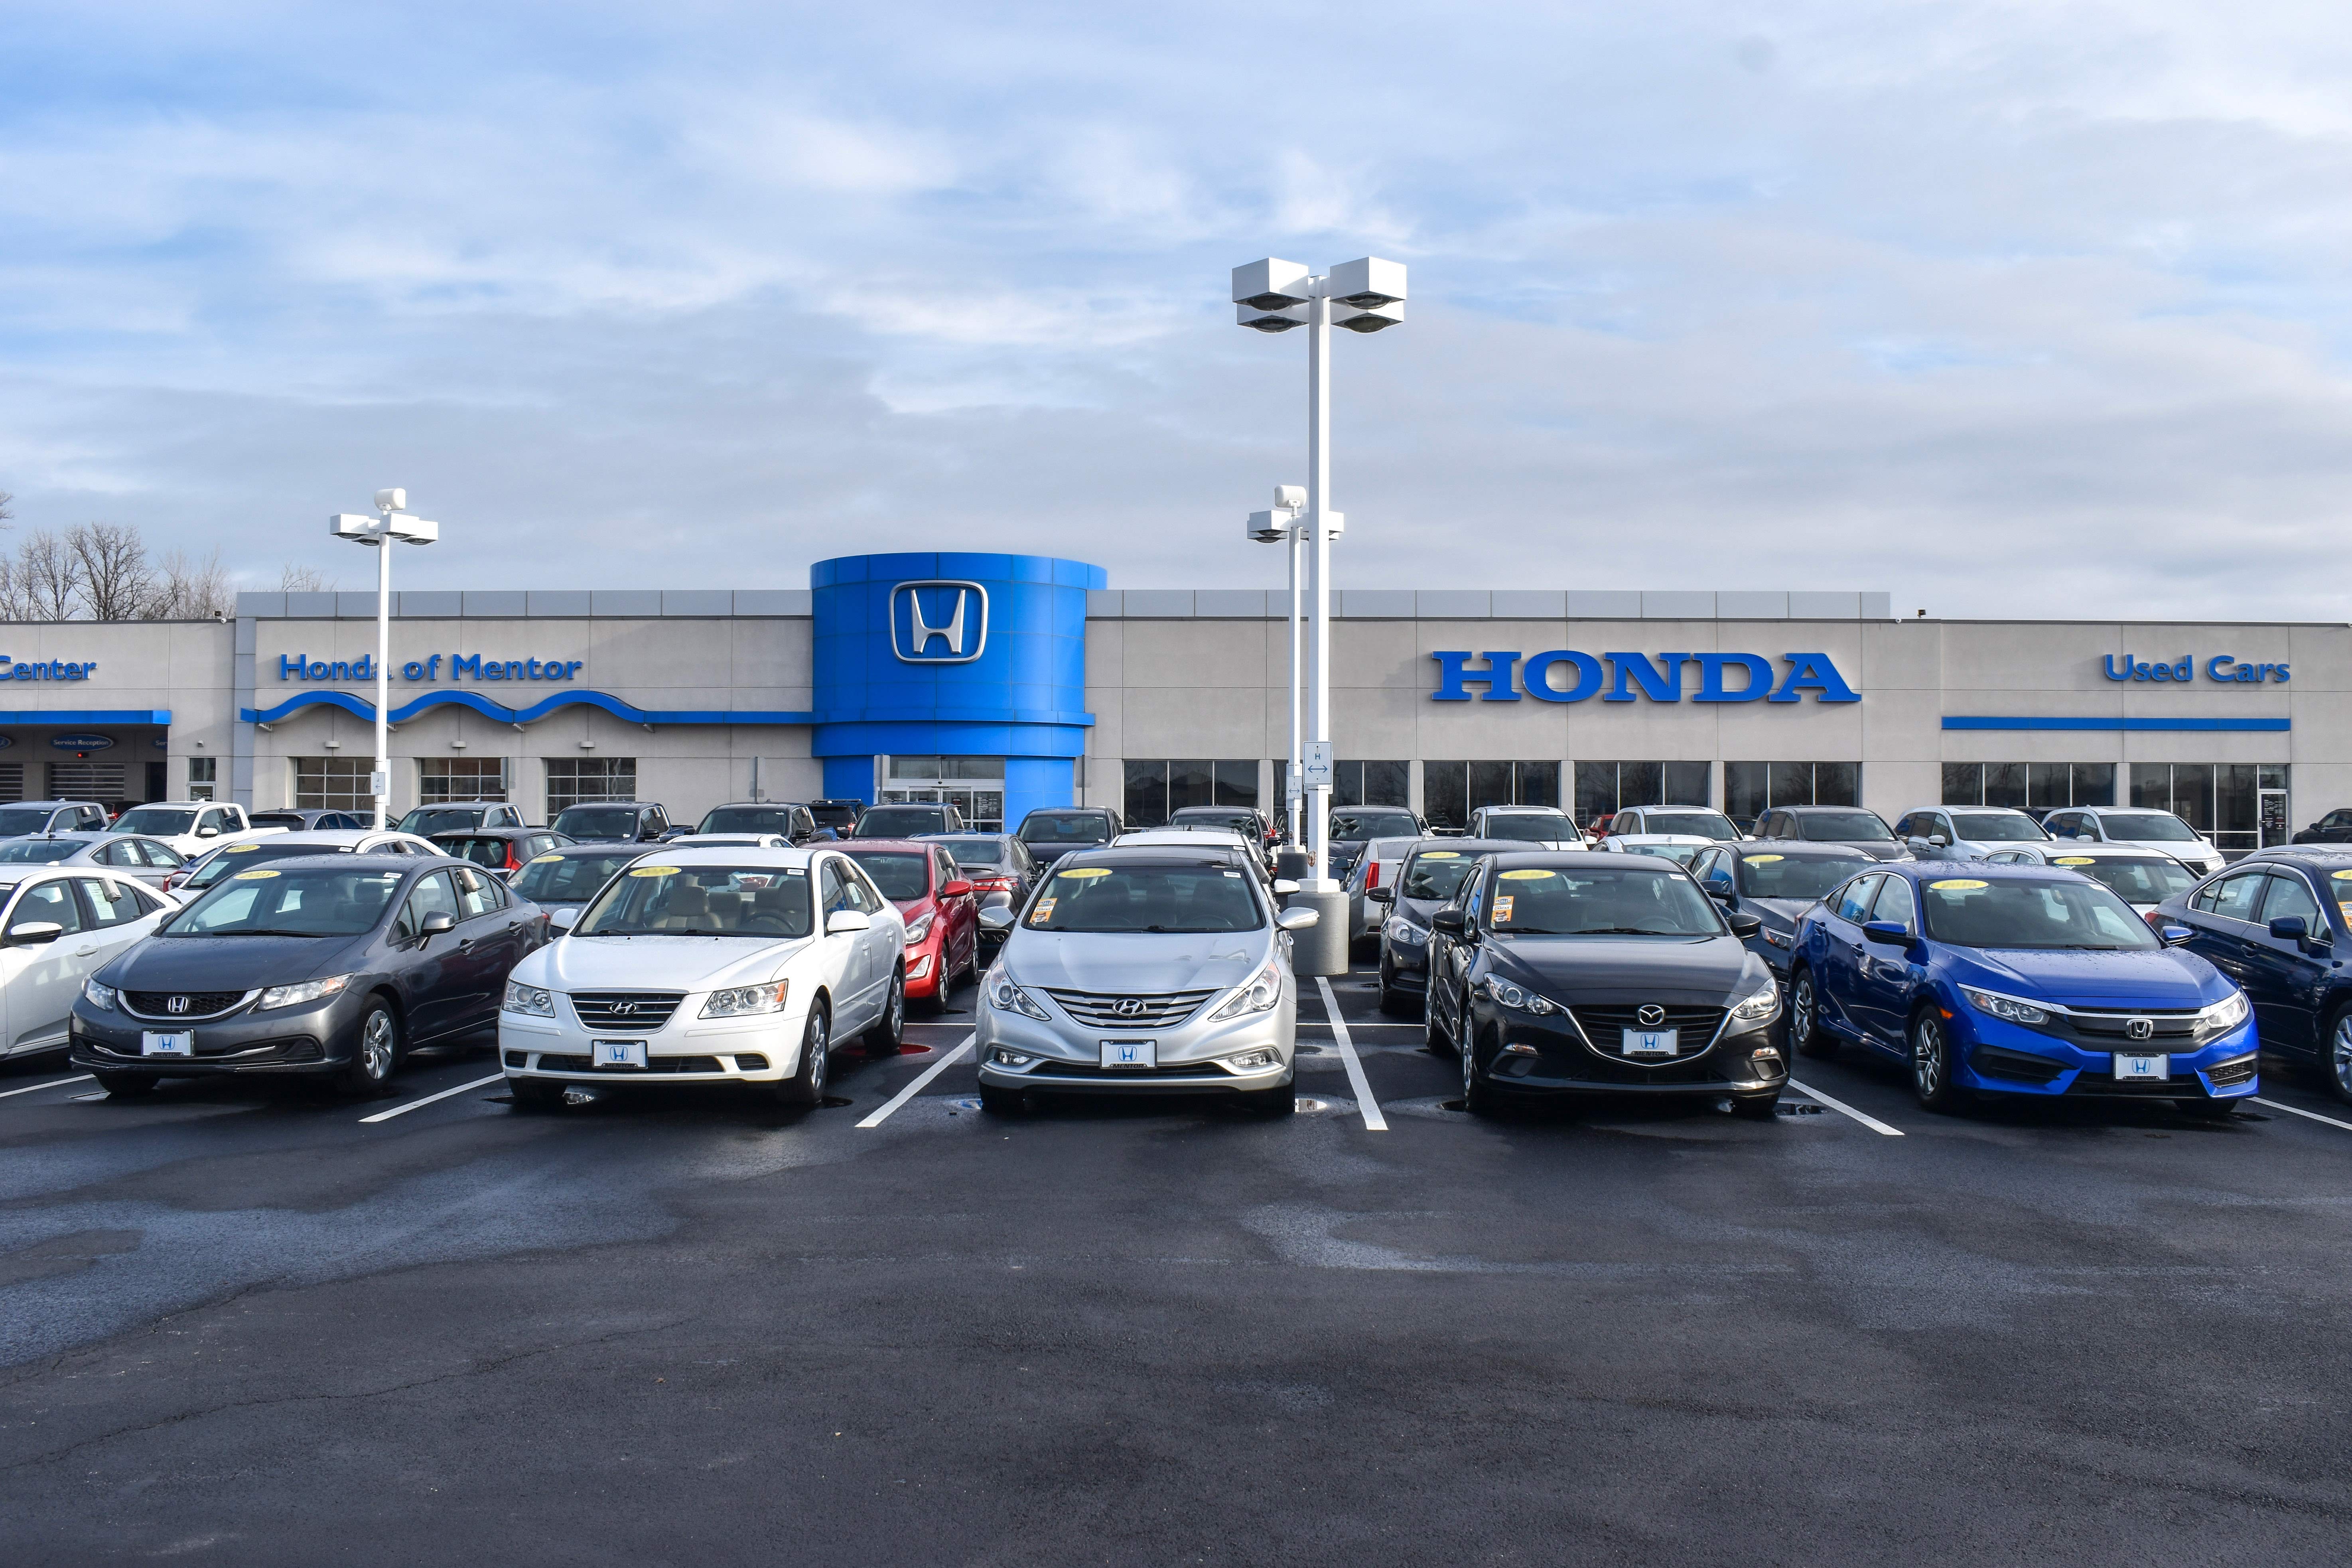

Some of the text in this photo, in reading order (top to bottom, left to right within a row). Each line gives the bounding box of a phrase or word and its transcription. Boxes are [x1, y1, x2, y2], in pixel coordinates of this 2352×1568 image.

[402, 654, 443, 680] of
[452, 653, 583, 680] Mentor
[1431, 650, 1862, 702] HONDA
[2104, 654, 2291, 682] Used Cars
